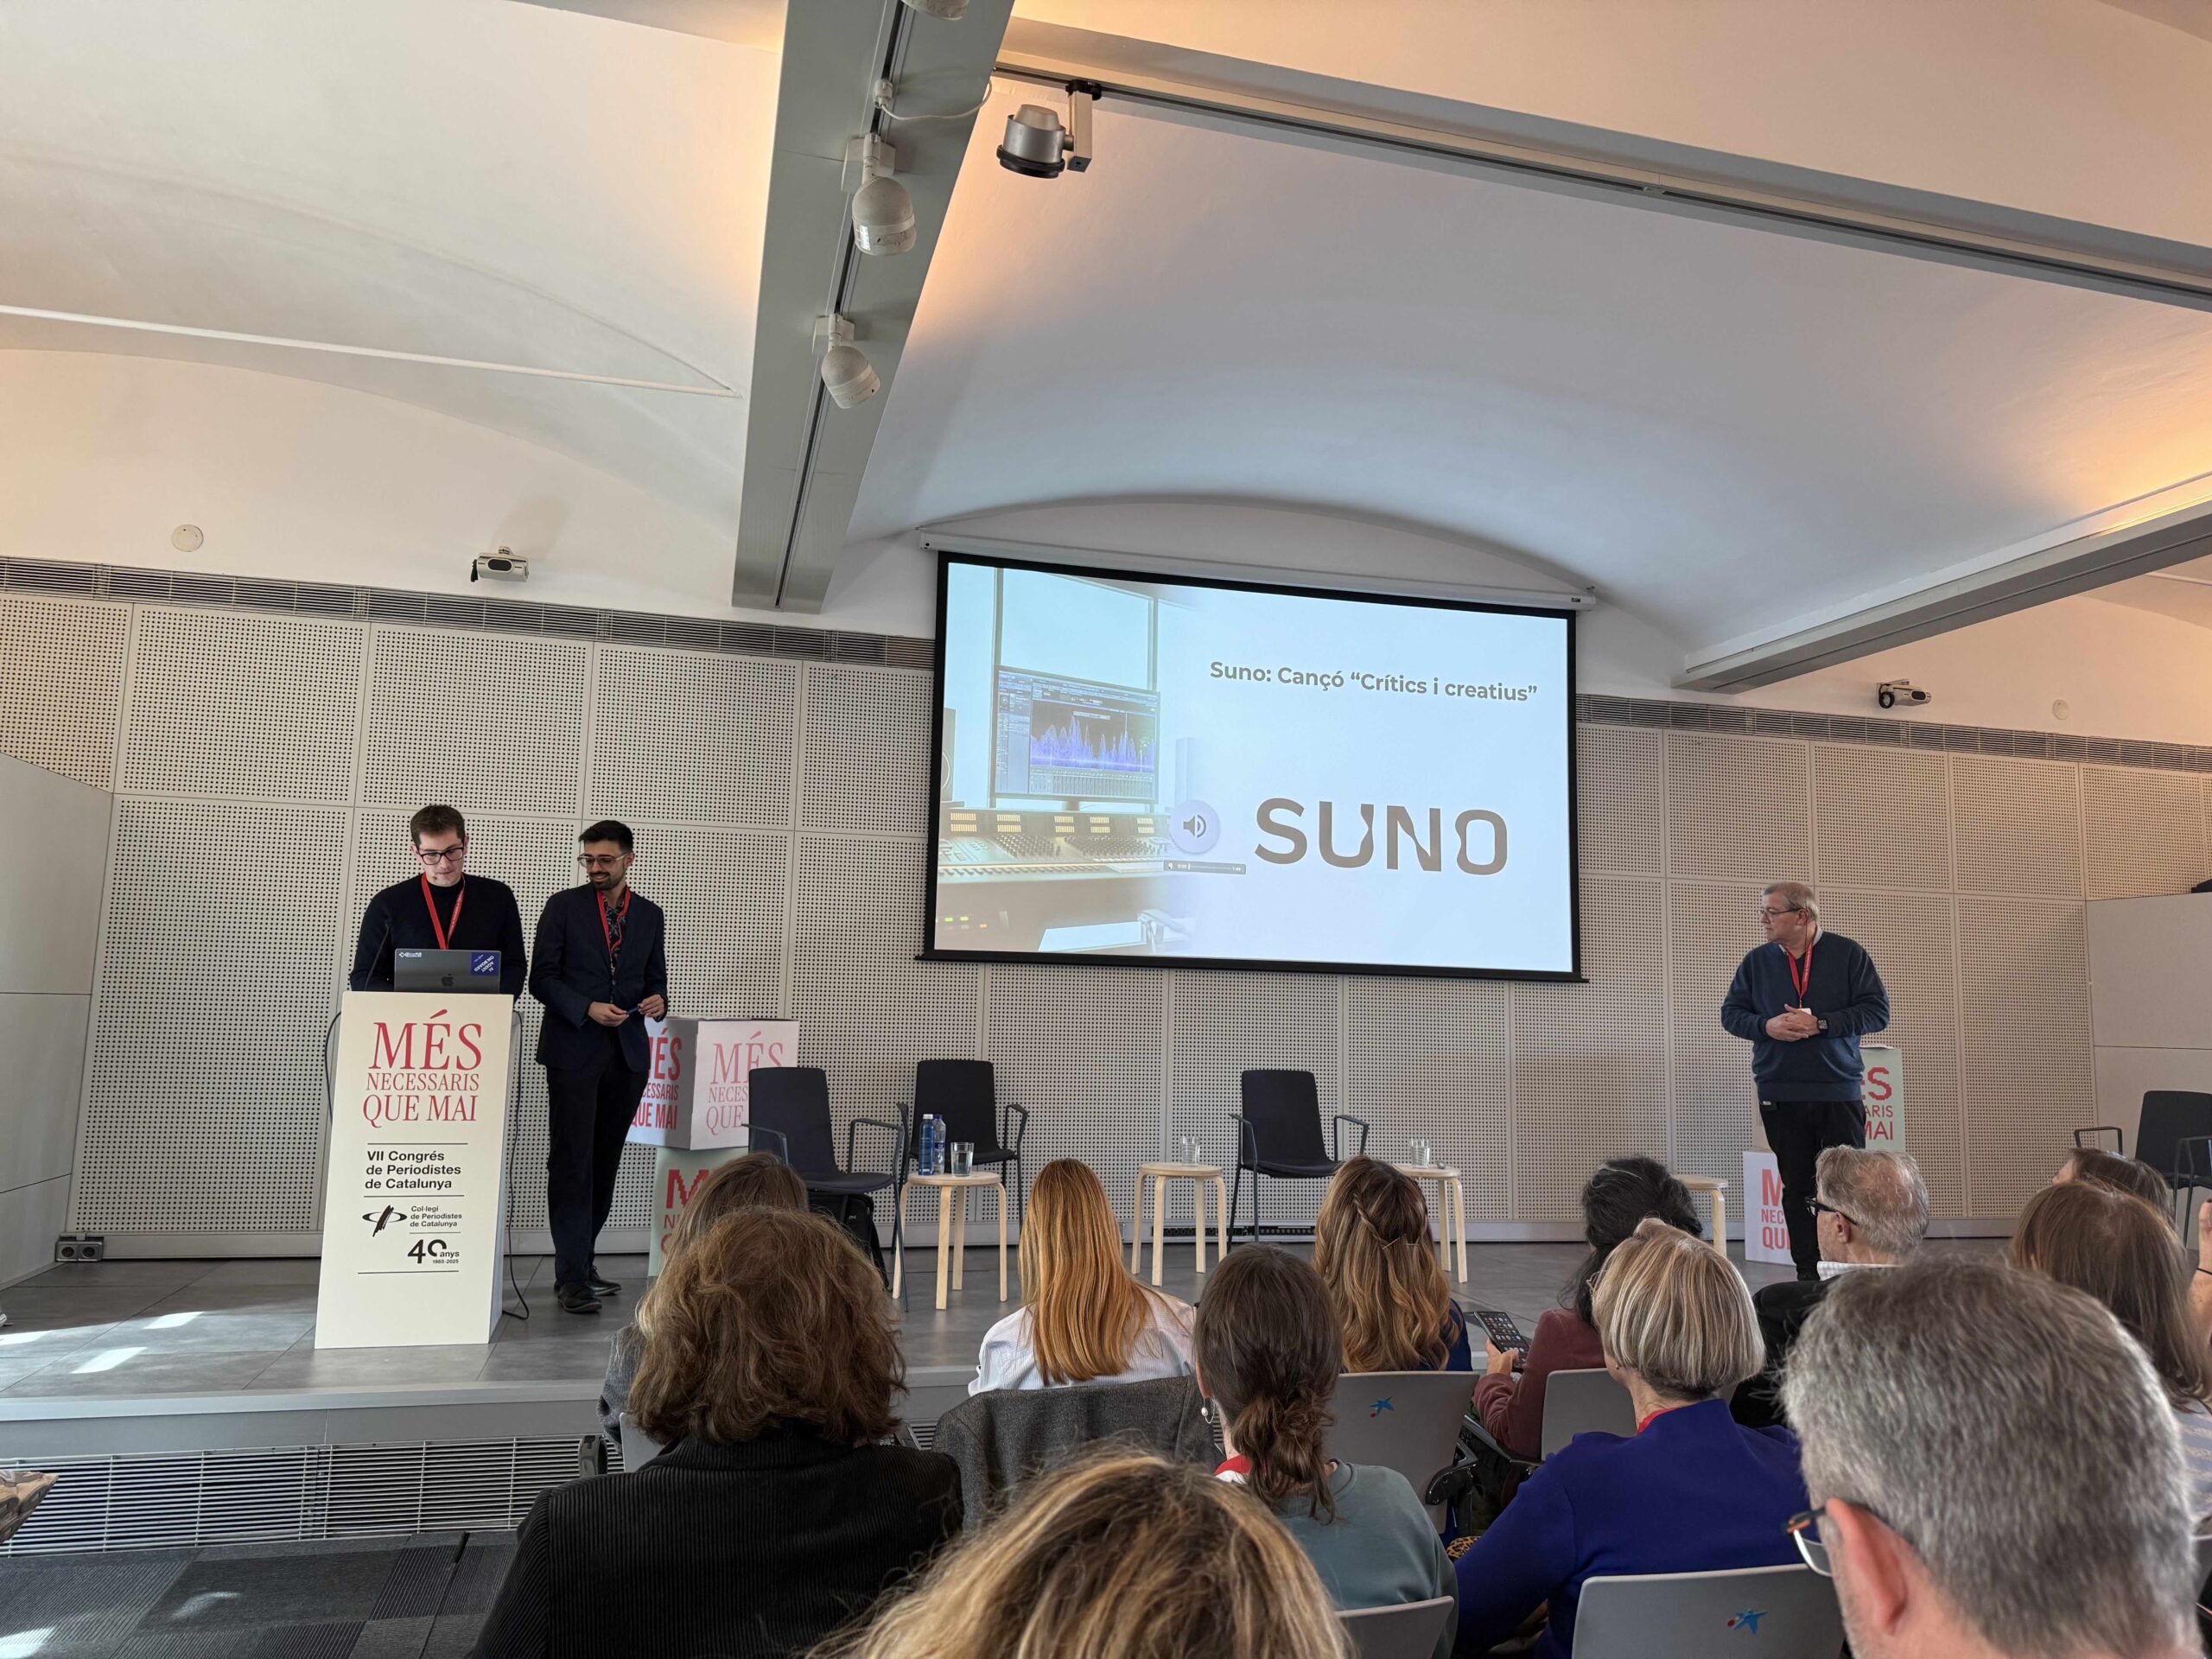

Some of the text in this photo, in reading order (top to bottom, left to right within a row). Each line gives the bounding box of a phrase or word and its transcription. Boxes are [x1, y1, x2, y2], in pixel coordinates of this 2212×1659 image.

[1210, 661, 1538, 702] Suno: Cançó “Crítics i creatius”
[1254, 798, 1508, 875] SUNO
[368, 1008, 482, 1071] MÉS
[365, 1072, 480, 1091] NECESSARIS
[708, 1086, 748, 1103] NECES
[363, 1094, 479, 1128] QUE MAI
[655, 1103, 678, 1130] MAI
[706, 1104, 744, 1135] QUE
[365, 1164, 461, 1175] de Periodistes
[366, 1150, 445, 1163] VII Congrés
[365, 1178, 452, 1191] de Catalunya
